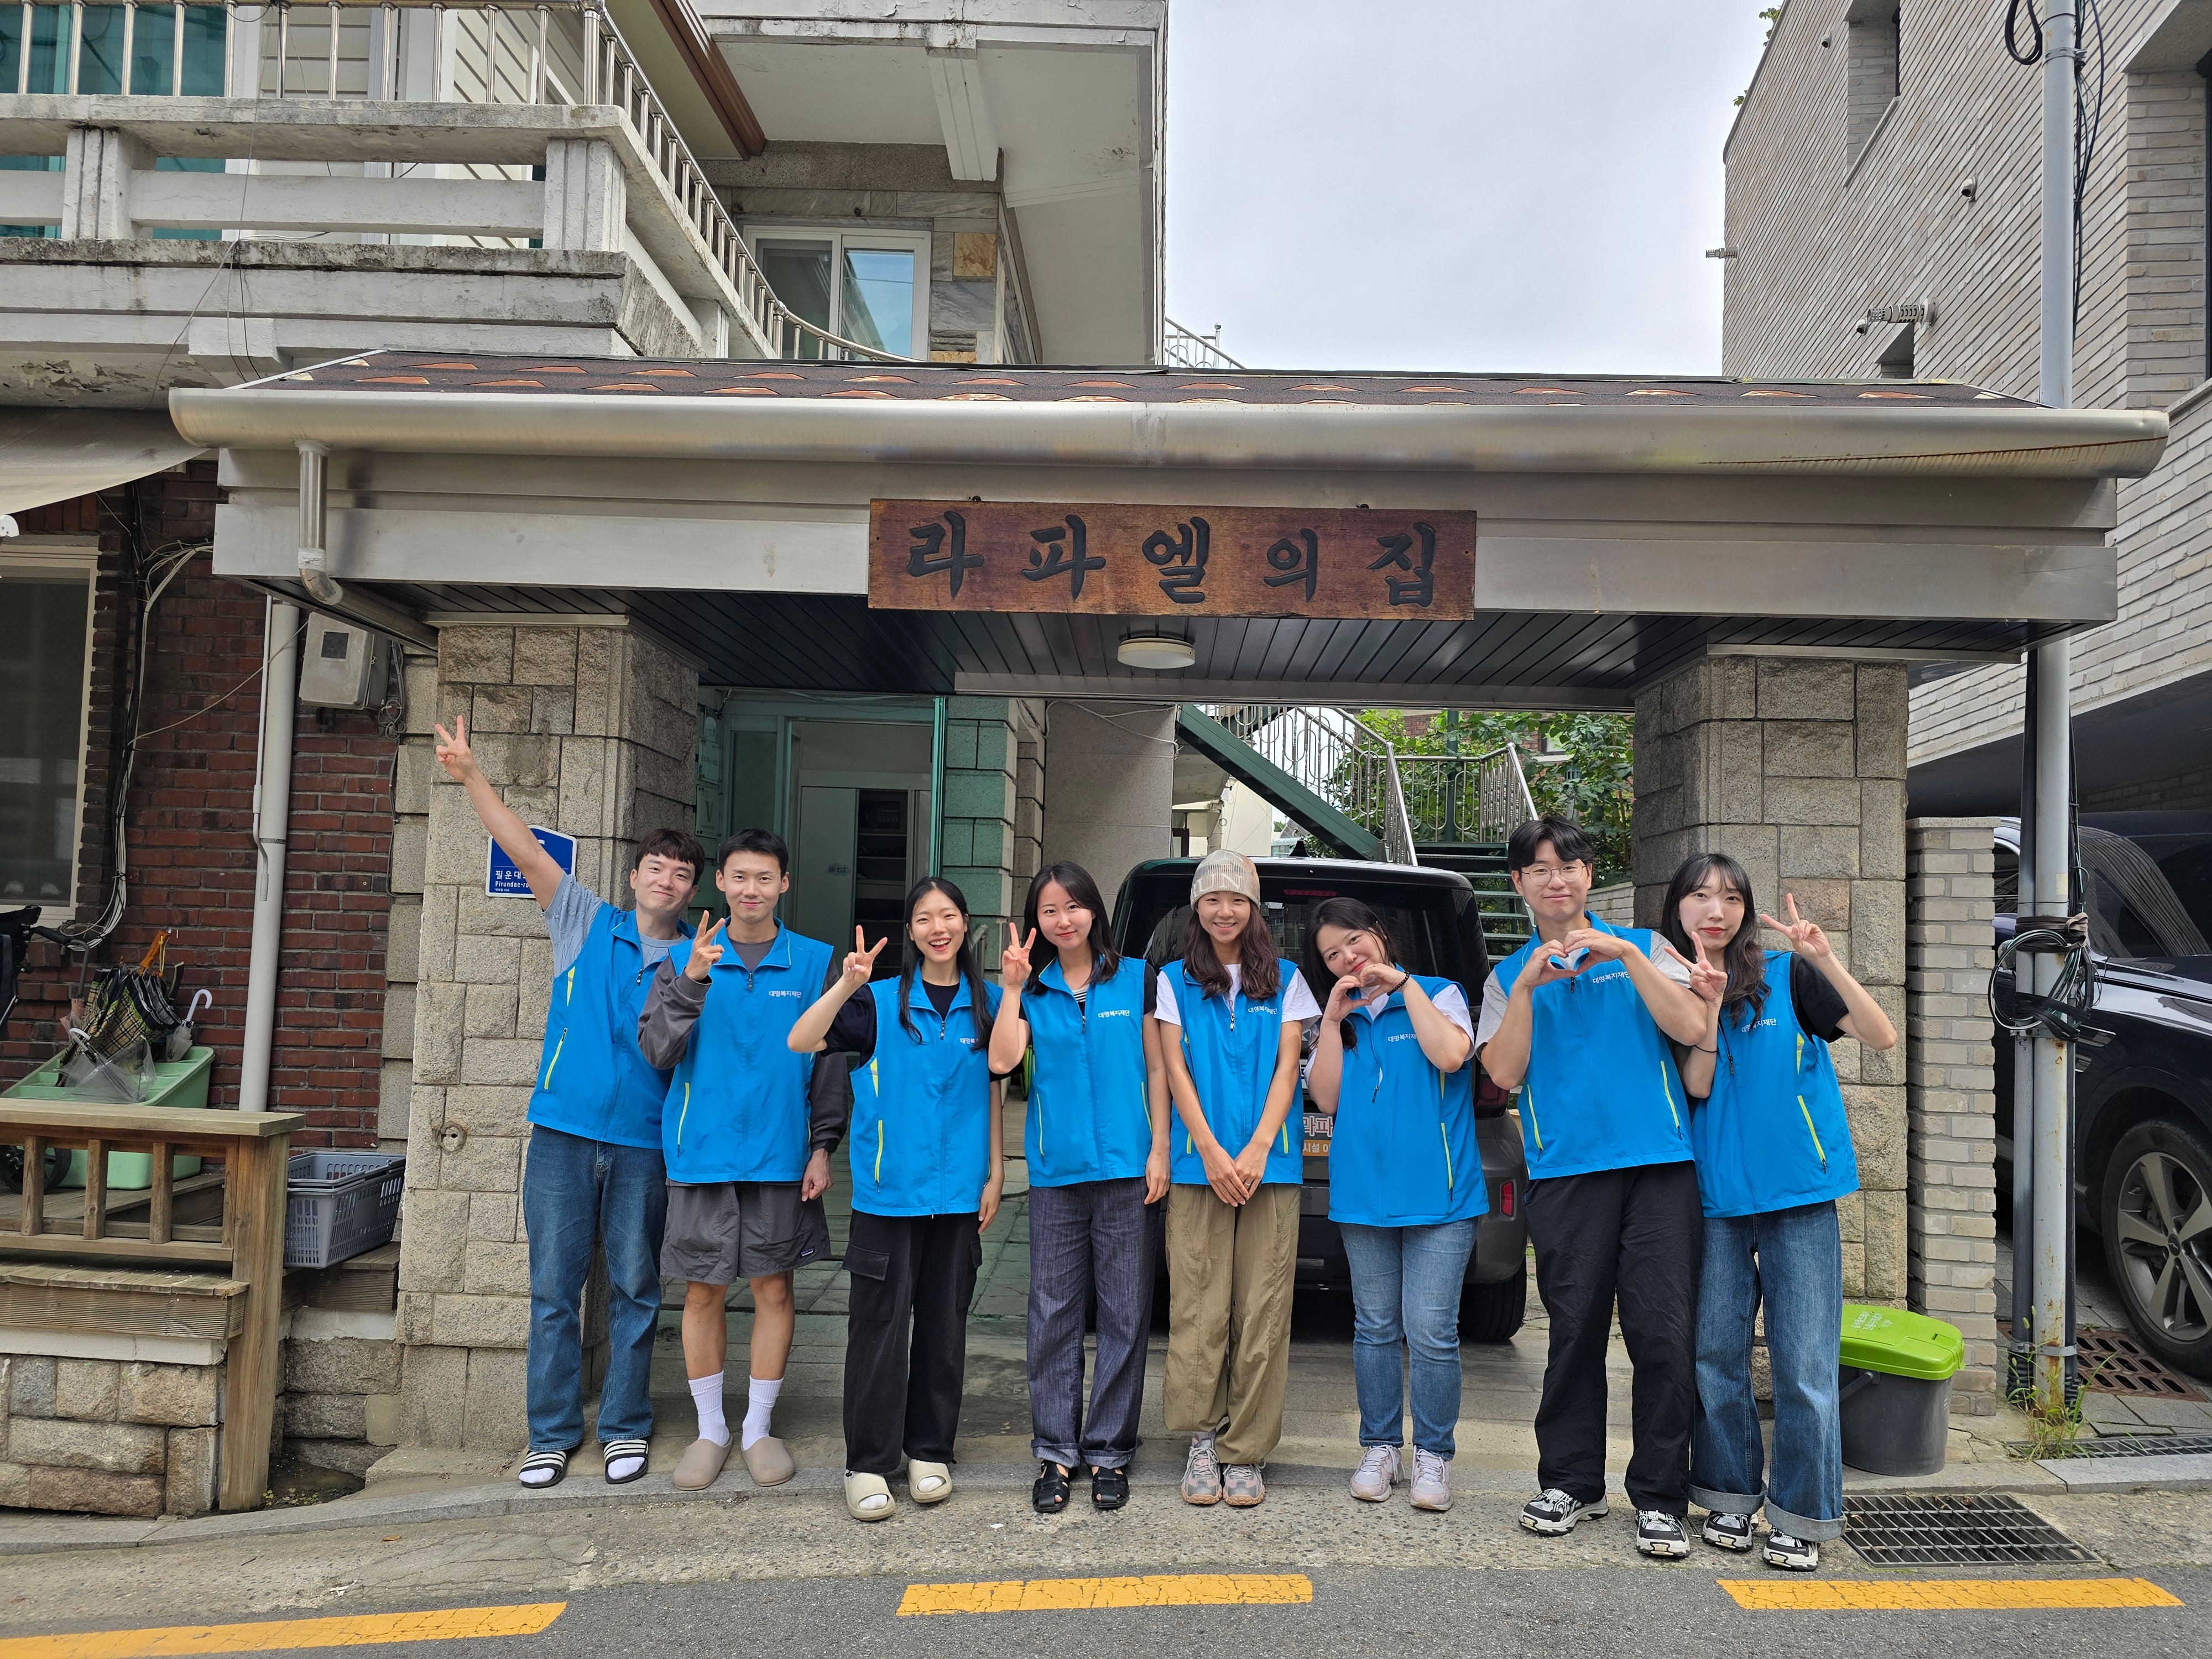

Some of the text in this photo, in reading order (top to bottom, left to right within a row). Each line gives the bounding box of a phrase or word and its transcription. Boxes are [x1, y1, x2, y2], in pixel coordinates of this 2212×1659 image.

[495, 870, 526, 880] 필운대
[1592, 971, 1630, 984] 대명복지재단
[768, 990, 802, 998] 대명복지재단
[1097, 1009, 1130, 1018] 대명복지재단
